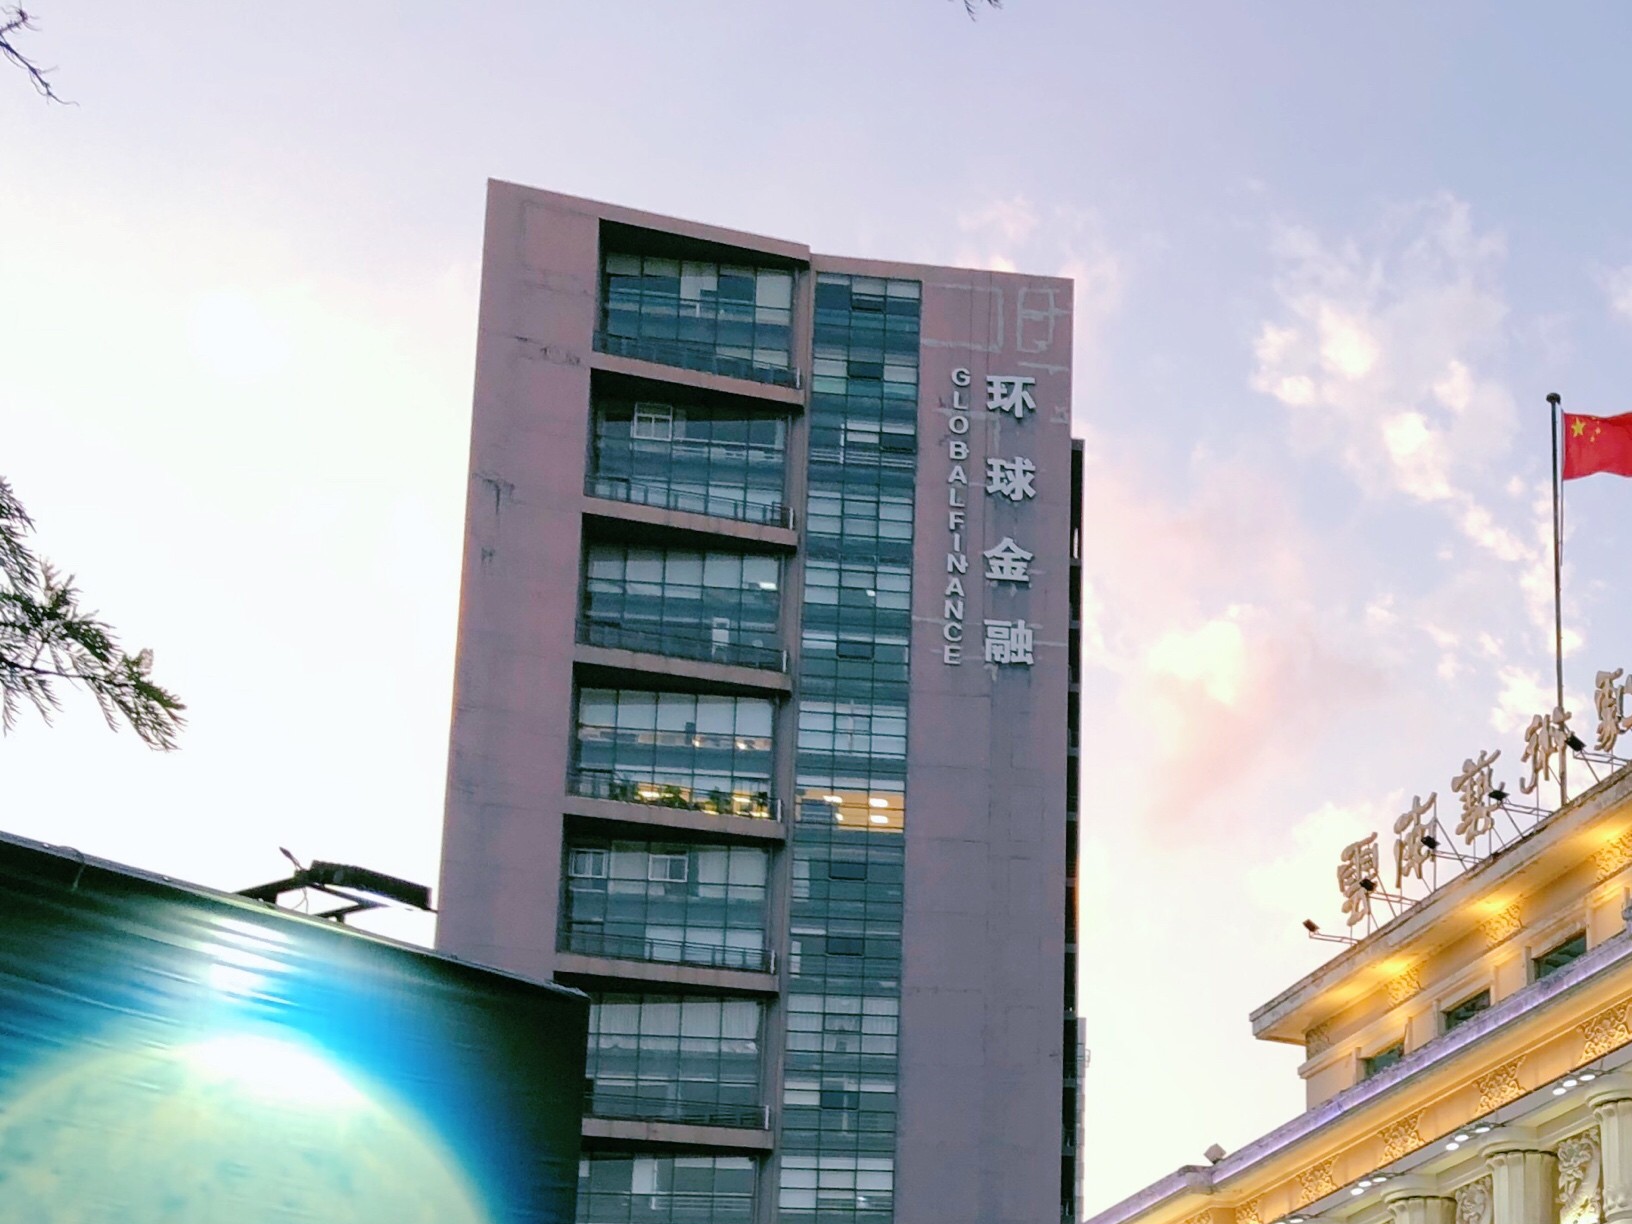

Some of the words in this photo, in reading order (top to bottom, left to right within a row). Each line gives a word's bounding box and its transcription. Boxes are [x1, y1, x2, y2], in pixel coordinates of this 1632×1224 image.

[943, 367, 971, 667] GLOBALFINANCE
[983, 374, 1037, 666] 环球金融
